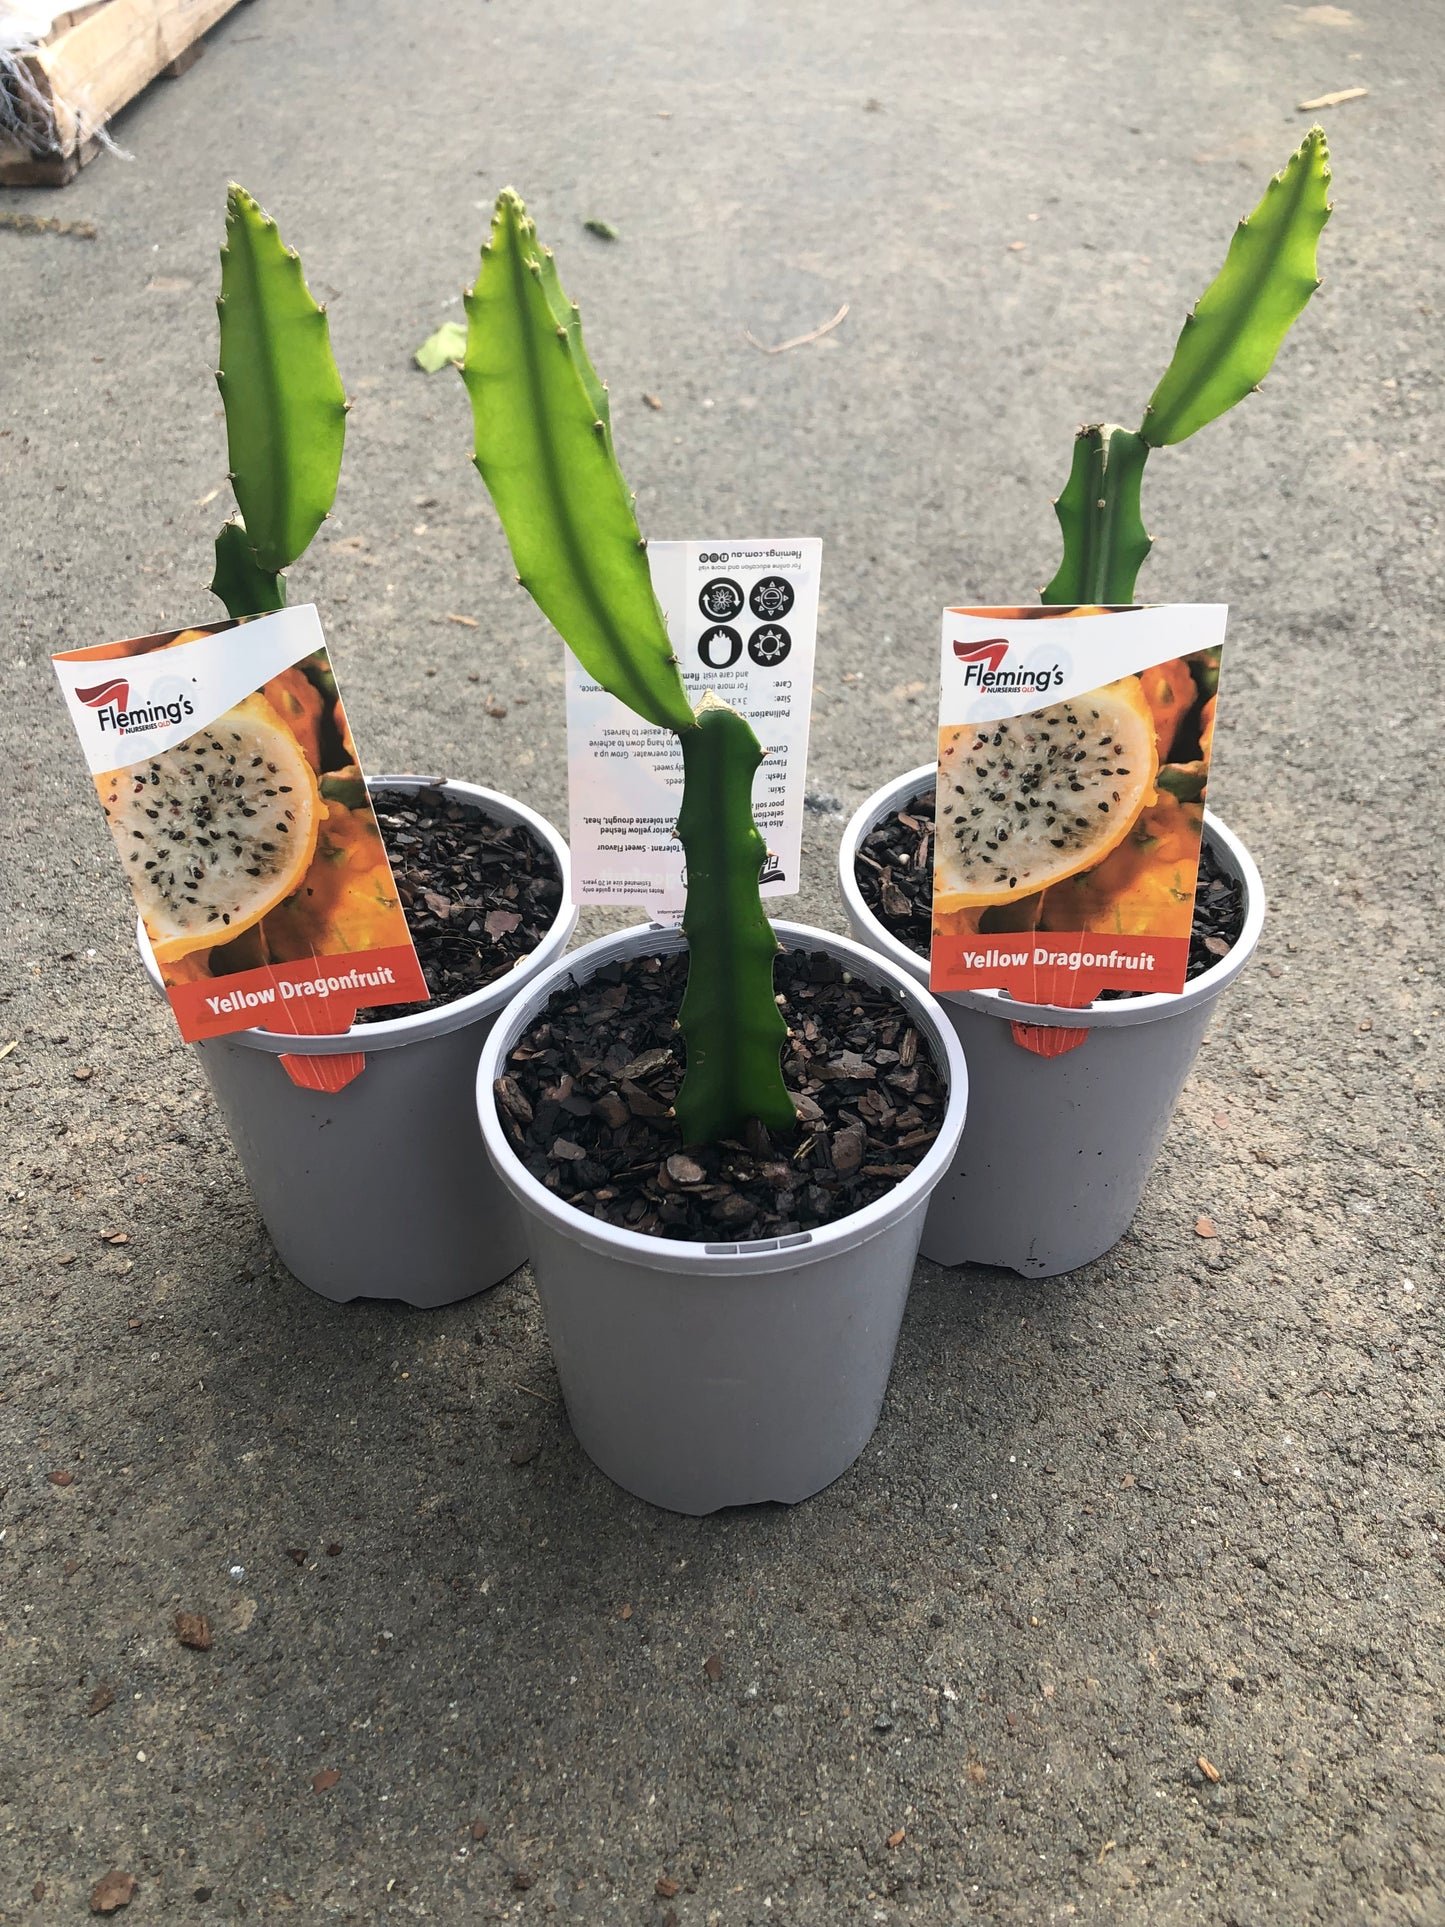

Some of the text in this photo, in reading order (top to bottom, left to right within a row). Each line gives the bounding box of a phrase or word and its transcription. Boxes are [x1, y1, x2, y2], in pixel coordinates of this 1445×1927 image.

[731, 550, 802, 559] flemings.com.au
[703, 672, 717, 680] visit
[735, 671, 748, 679] and
[964, 664, 1063, 692] Fleming's
[773, 680, 792, 688] Care:
[774, 695, 791, 703] Size:
[98, 694, 194, 731] Fleming's
[748, 710, 790, 719] Pollination:
[125, 723, 157, 734] NURSERIES
[602, 729, 630, 737] harvest.
[589, 740, 615, 748] acheive
[626, 740, 645, 748] down
[611, 751, 628, 759] Grow
[769, 799, 785, 807] poor
[754, 810, 784, 818] selection
[603, 816, 634, 825] drought,
[636, 817, 663, 825] tolerate
[664, 817, 678, 825] Can
[769, 820, 784, 828] Also
[600, 825, 674, 835] perior yellow fleshed
[597, 844, 623, 852] Flavour
[625, 844, 646, 852] Sweet
[963, 949, 1155, 971] Yellow Dragonfruit
[205, 967, 395, 1015] Yellow Dragonfruit
